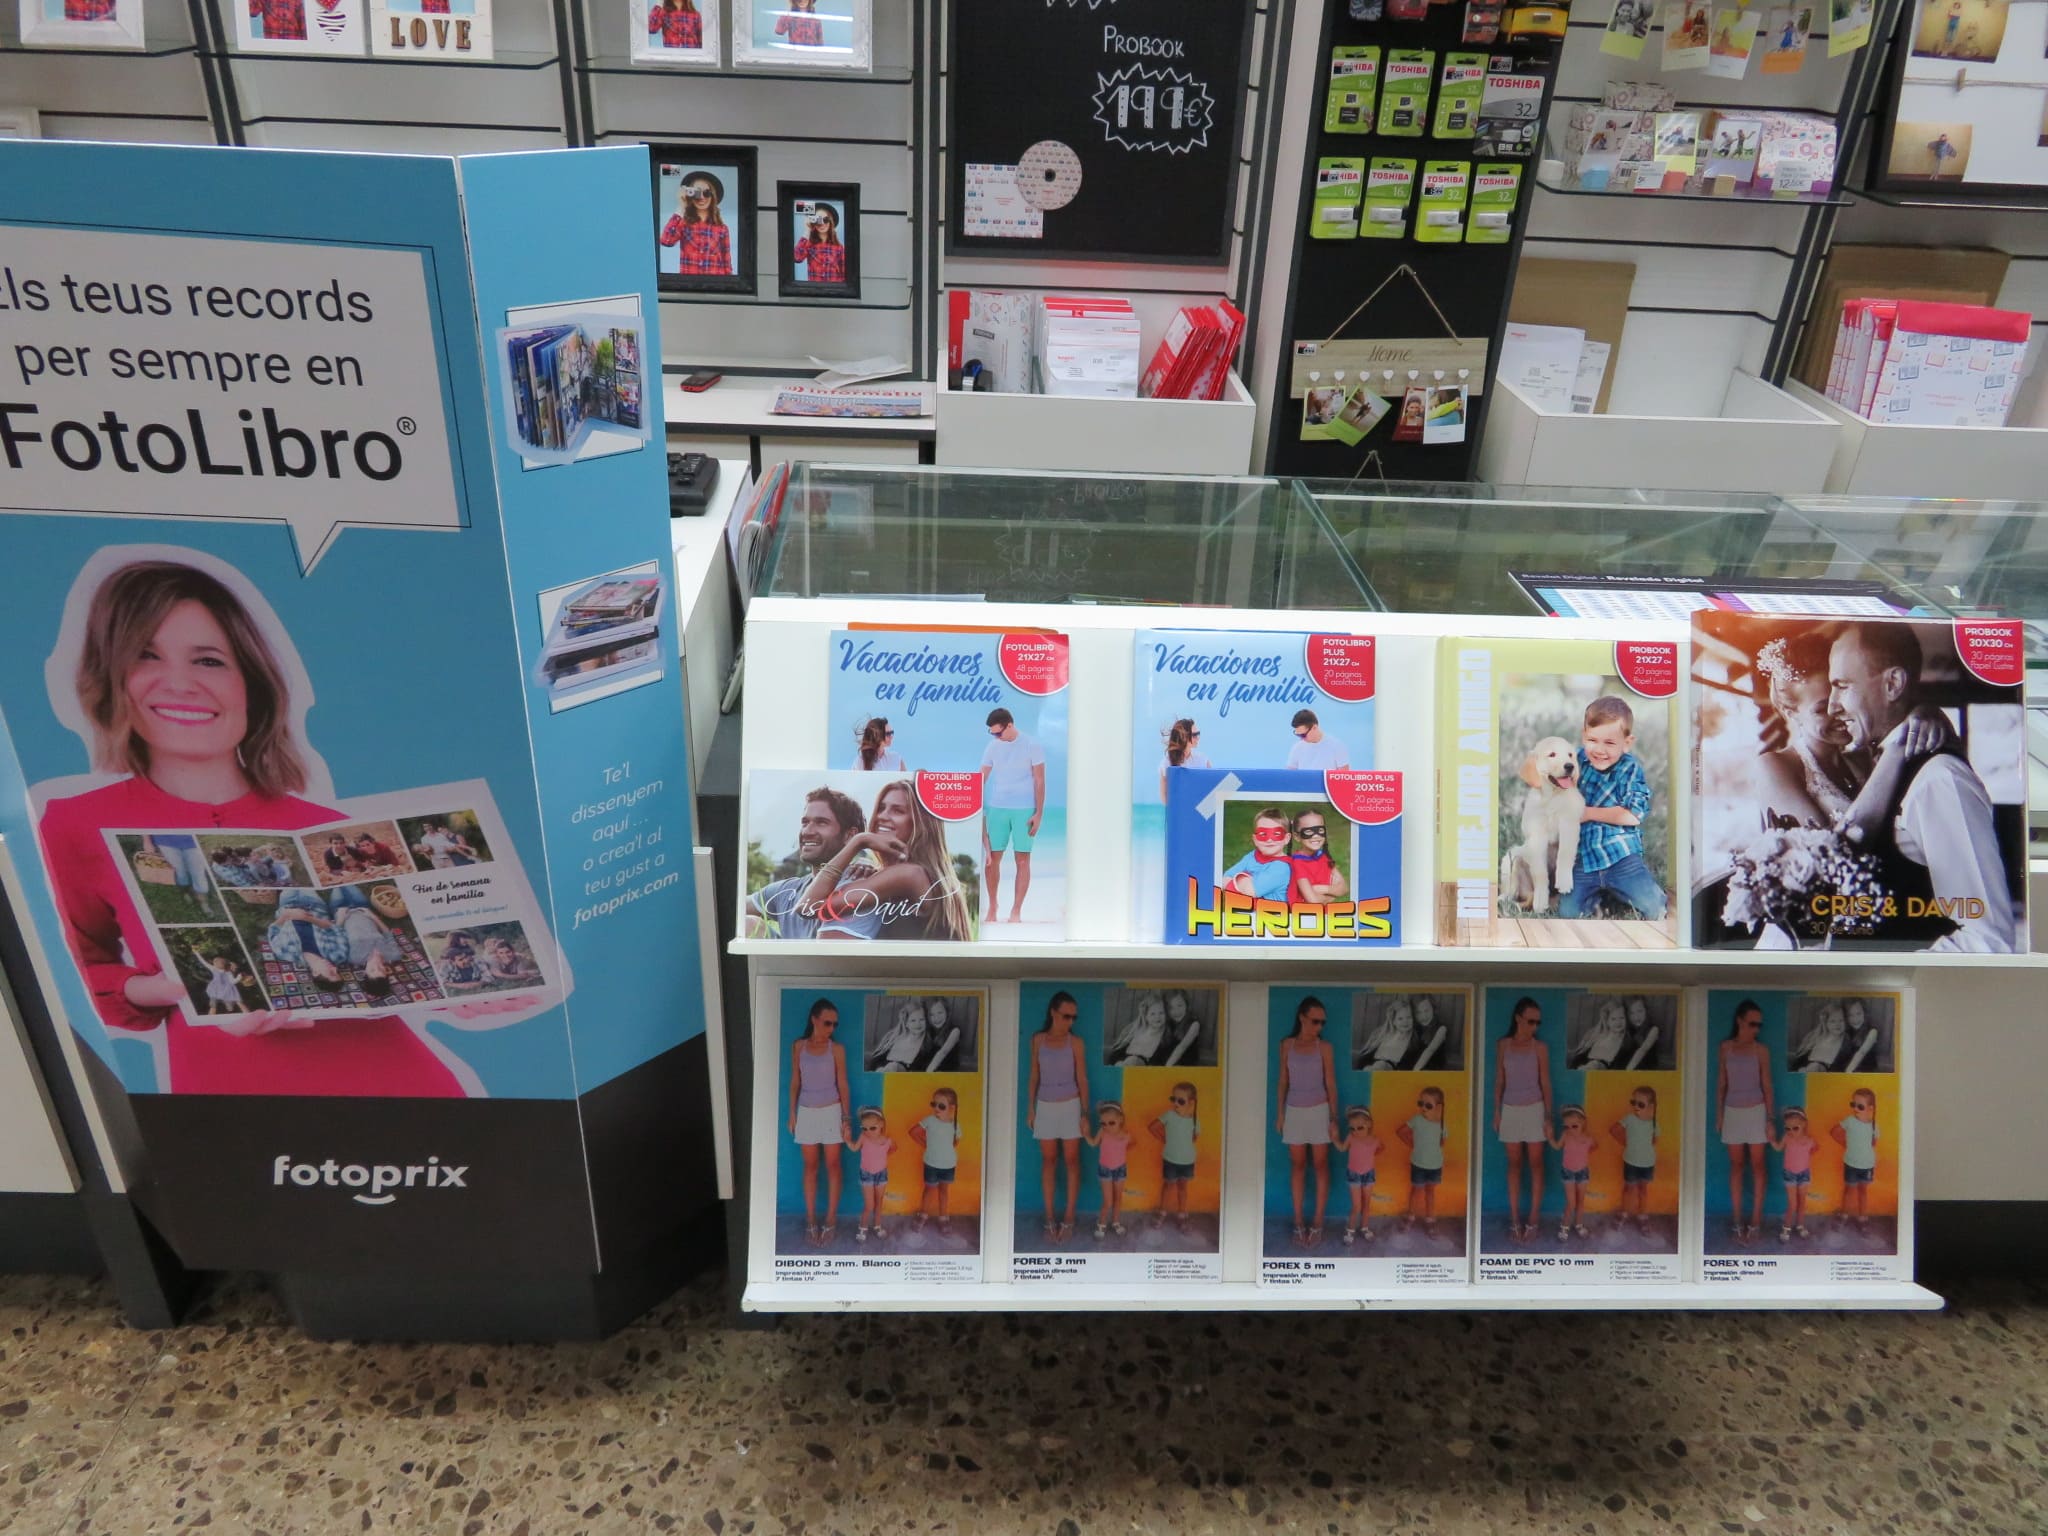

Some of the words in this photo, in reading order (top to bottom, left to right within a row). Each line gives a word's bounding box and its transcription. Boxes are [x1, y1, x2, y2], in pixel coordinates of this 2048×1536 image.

[390, 16, 472, 49] LOVE
[1389, 64, 1429, 74] TOSHIBA
[1488, 77, 1541, 89] TOSHIBA
[1106, 85, 1203, 129] 199€
[1514, 103, 1532, 117] 32
[1371, 171, 1410, 181] TOSHIBA
[1427, 175, 1465, 184] TOSHIBA
[1477, 177, 1515, 186] TOSHIBA
[61, 273, 172, 316] teus
[187, 279, 374, 324] records
[1367, 345, 1414, 363] Home
[14, 344, 91, 386] per
[109, 346, 292, 392] sempre
[307, 354, 364, 387] en
[1964, 627, 2013, 637] PROBOOK
[1005, 643, 1055, 651] FOTOLIBRO
[1322, 638, 1372, 647] FOTOLIBRO
[1968, 638, 2003, 648] 30X30
[1323, 648, 1345, 656] PLUS
[1629, 646, 1672, 655] PROBOOK
[1970, 650, 1983, 660] 30
[839, 638, 984, 674] Vacaciones
[1017, 653, 1046, 661] 21X27
[1155, 642, 1282, 677] Vacaciones
[1635, 655, 1663, 664] 21X27
[1323, 658, 1350, 666] 21X27
[1324, 669, 1335, 677] 20
[1634, 666, 1645, 675] 20
[875, 681, 906, 701] en
[906, 676, 1004, 717] familia
[1187, 681, 1218, 701] en
[1219, 675, 1316, 718] familia
[603, 761, 631, 785] Te'l
[923, 773, 972, 781] FOTOLIBRO
[1329, 773, 1373, 781] FOTOLIBRO
[934, 782, 962, 791] 20X15
[1355, 783, 1385, 792] 20X15
[571, 780, 664, 824] dissenyem
[1354, 794, 1366, 803] 20
[583, 858, 594, 872] o
[599, 833, 643, 866] crea'l
[647, 826, 663, 846] al
[584, 875, 612, 896] teu
[615, 858, 651, 887] gust
[654, 853, 666, 867] a
[411, 883, 433, 894] Fin
[436, 881, 449, 891] de
[430, 897, 444, 905] en
[446, 889, 484, 904] familia
[572, 871, 679, 931] fotoprix.com
[765, 888, 825, 916] Cris
[843, 877, 962, 925] David
[1188, 875, 1392, 939] HEROES
[1811, 894, 1873, 917] CRIS
[1881, 896, 1898, 918] &
[1907, 896, 1985, 919] DAVID
[1809, 921, 1826, 935] 30
[273, 1155, 470, 1194] fotoprix
[775, 1259, 821, 1268] DIBOND
[824, 1259, 832, 1268] 3
[834, 1260, 859, 1268] mm.
[862, 1259, 902, 1268] Blanco
[1013, 1257, 1051, 1266] FOREX
[1054, 1257, 1063, 1266] 3
[1065, 1258, 1087, 1266] mm
[1262, 1261, 1301, 1270] FOREX
[1303, 1261, 1312, 1270] 5
[1314, 1262, 1335, 1270] mm
[1480, 1258, 1512, 1266] FOAM
[1515, 1258, 1530, 1266] DE
[1533, 1258, 1556, 1266] PVC
[1559, 1258, 1572, 1266] 10
[1703, 1259, 1740, 1267] FOREX
[1742, 1259, 1755, 1267] 10
